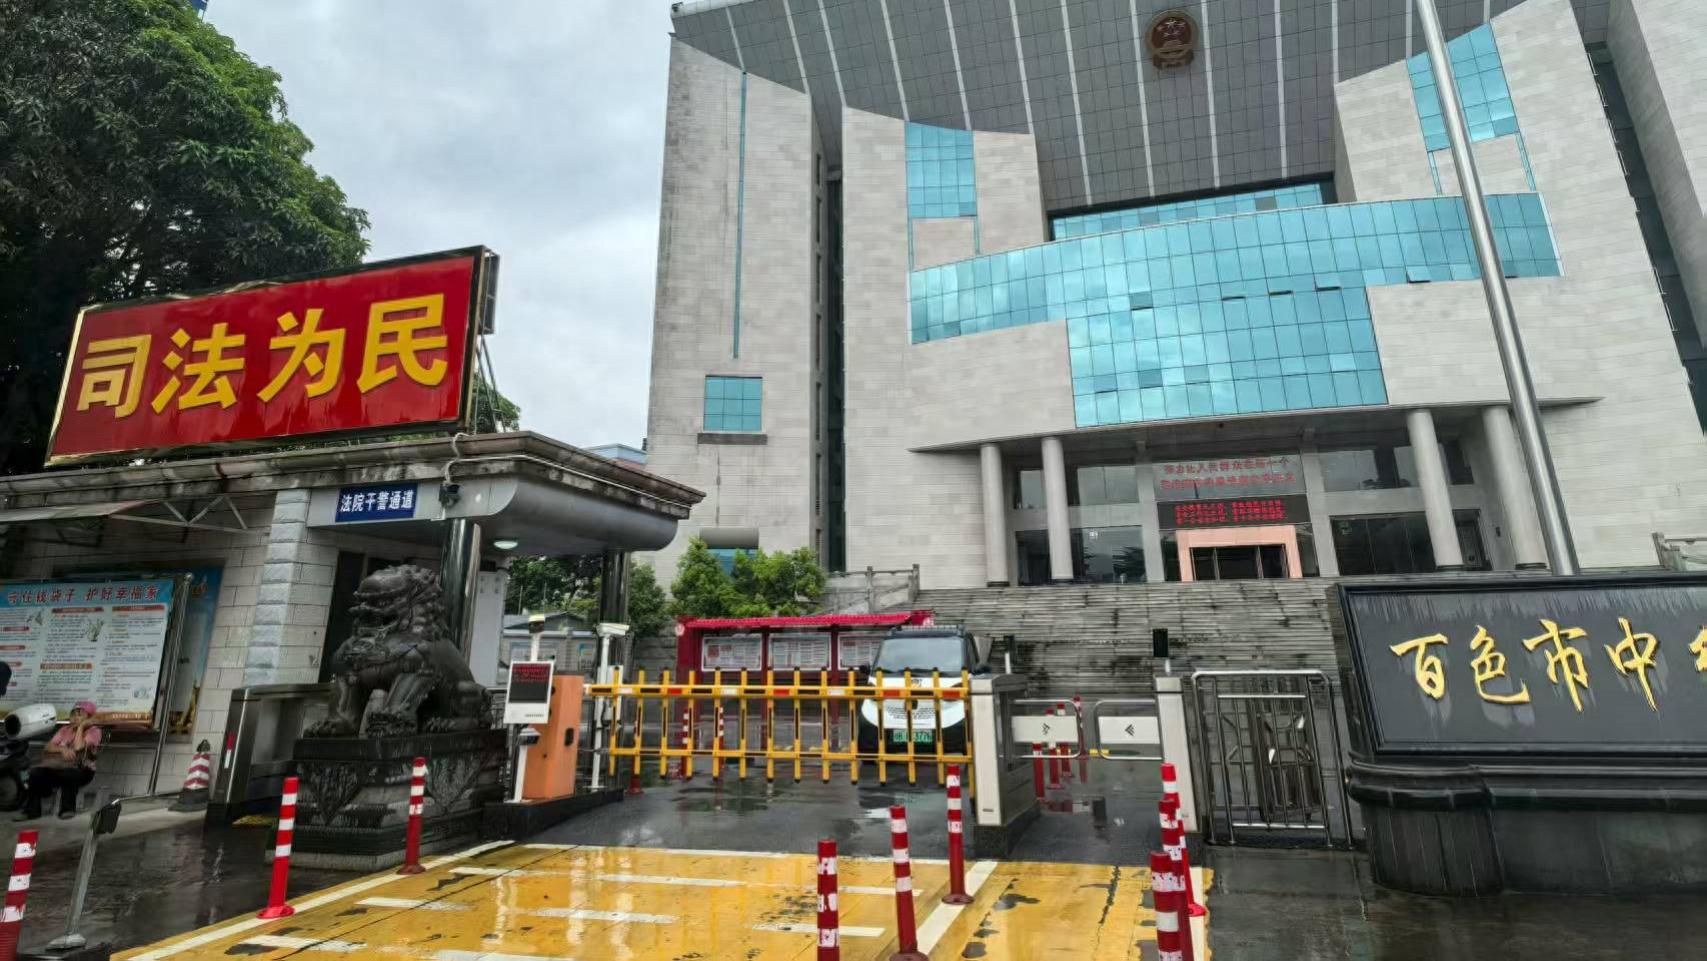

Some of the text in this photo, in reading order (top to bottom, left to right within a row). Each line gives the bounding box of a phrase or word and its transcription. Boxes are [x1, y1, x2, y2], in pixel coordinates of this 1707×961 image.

[76, 293, 449, 419] 司法为民
[340, 489, 414, 512] 法院干警通道
